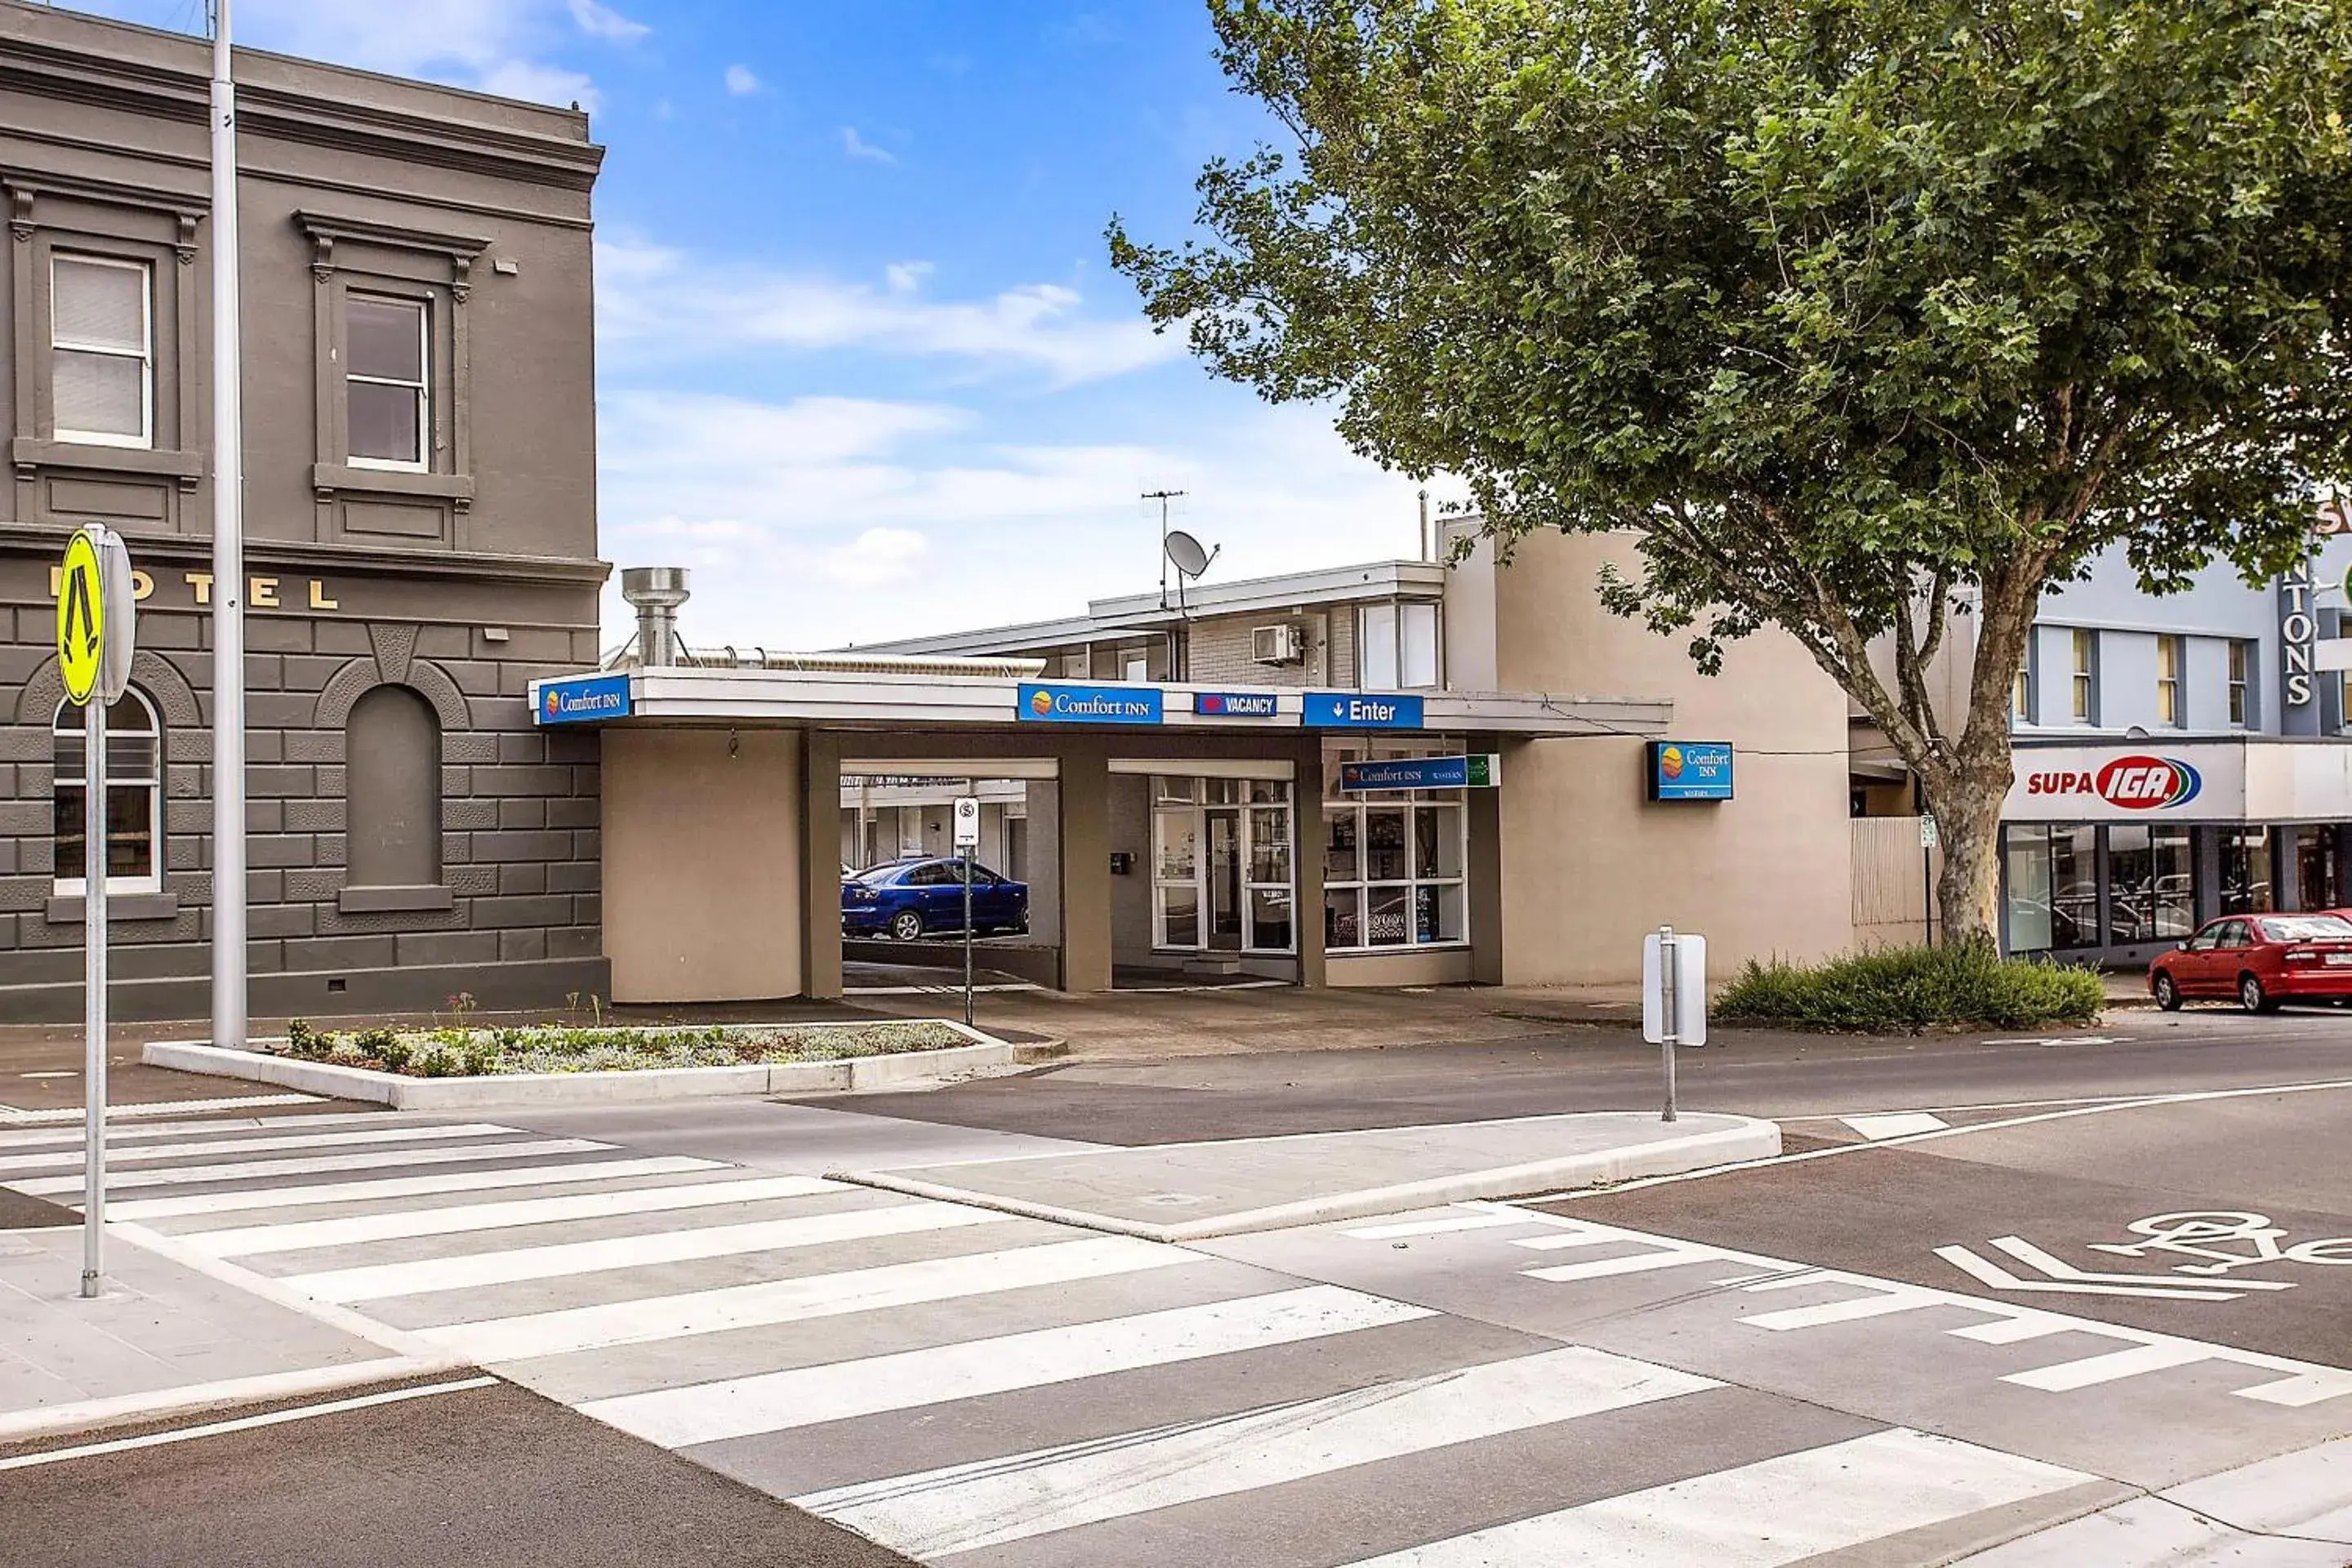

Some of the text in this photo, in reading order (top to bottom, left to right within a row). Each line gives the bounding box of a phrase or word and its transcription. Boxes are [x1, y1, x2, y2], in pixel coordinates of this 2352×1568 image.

[560, 689, 621, 712] Comfort INN
[1055, 694, 1150, 715] Comfort INN
[1226, 697, 1274, 713] VACANCY
[1350, 700, 1396, 721] Enter
[1686, 750, 1729, 765] Comfort
[1360, 765, 1404, 782] Comfort
[2028, 766, 2171, 800] SUPA IGA
